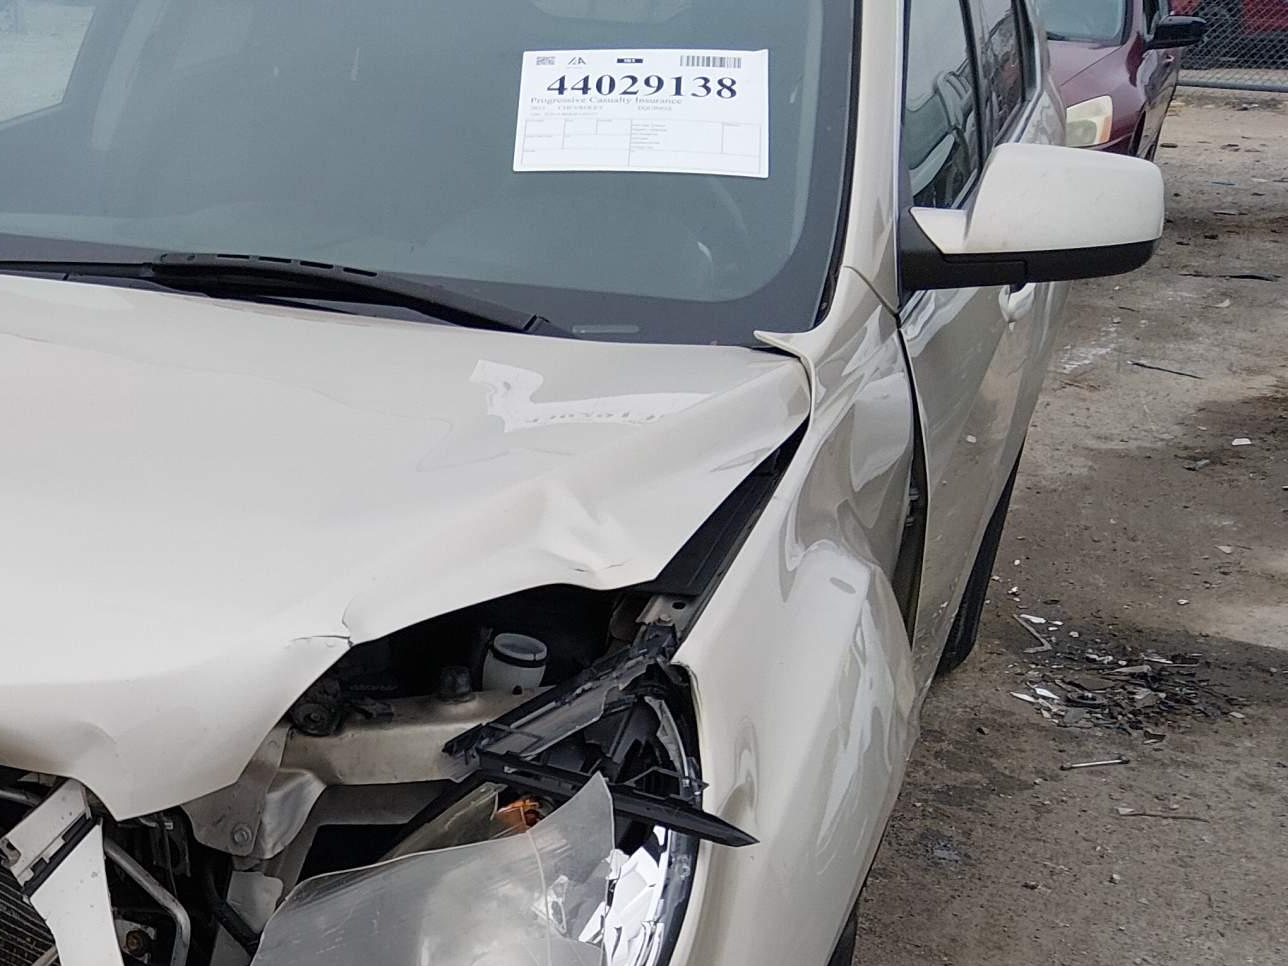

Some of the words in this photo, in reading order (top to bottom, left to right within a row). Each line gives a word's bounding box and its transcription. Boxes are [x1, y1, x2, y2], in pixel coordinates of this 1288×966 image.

[546, 75, 738, 99] 44029138
[530, 97, 585, 105] Progressive
[589, 97, 632, 105] Casualty
[635, 97, 682, 105] Insurance
